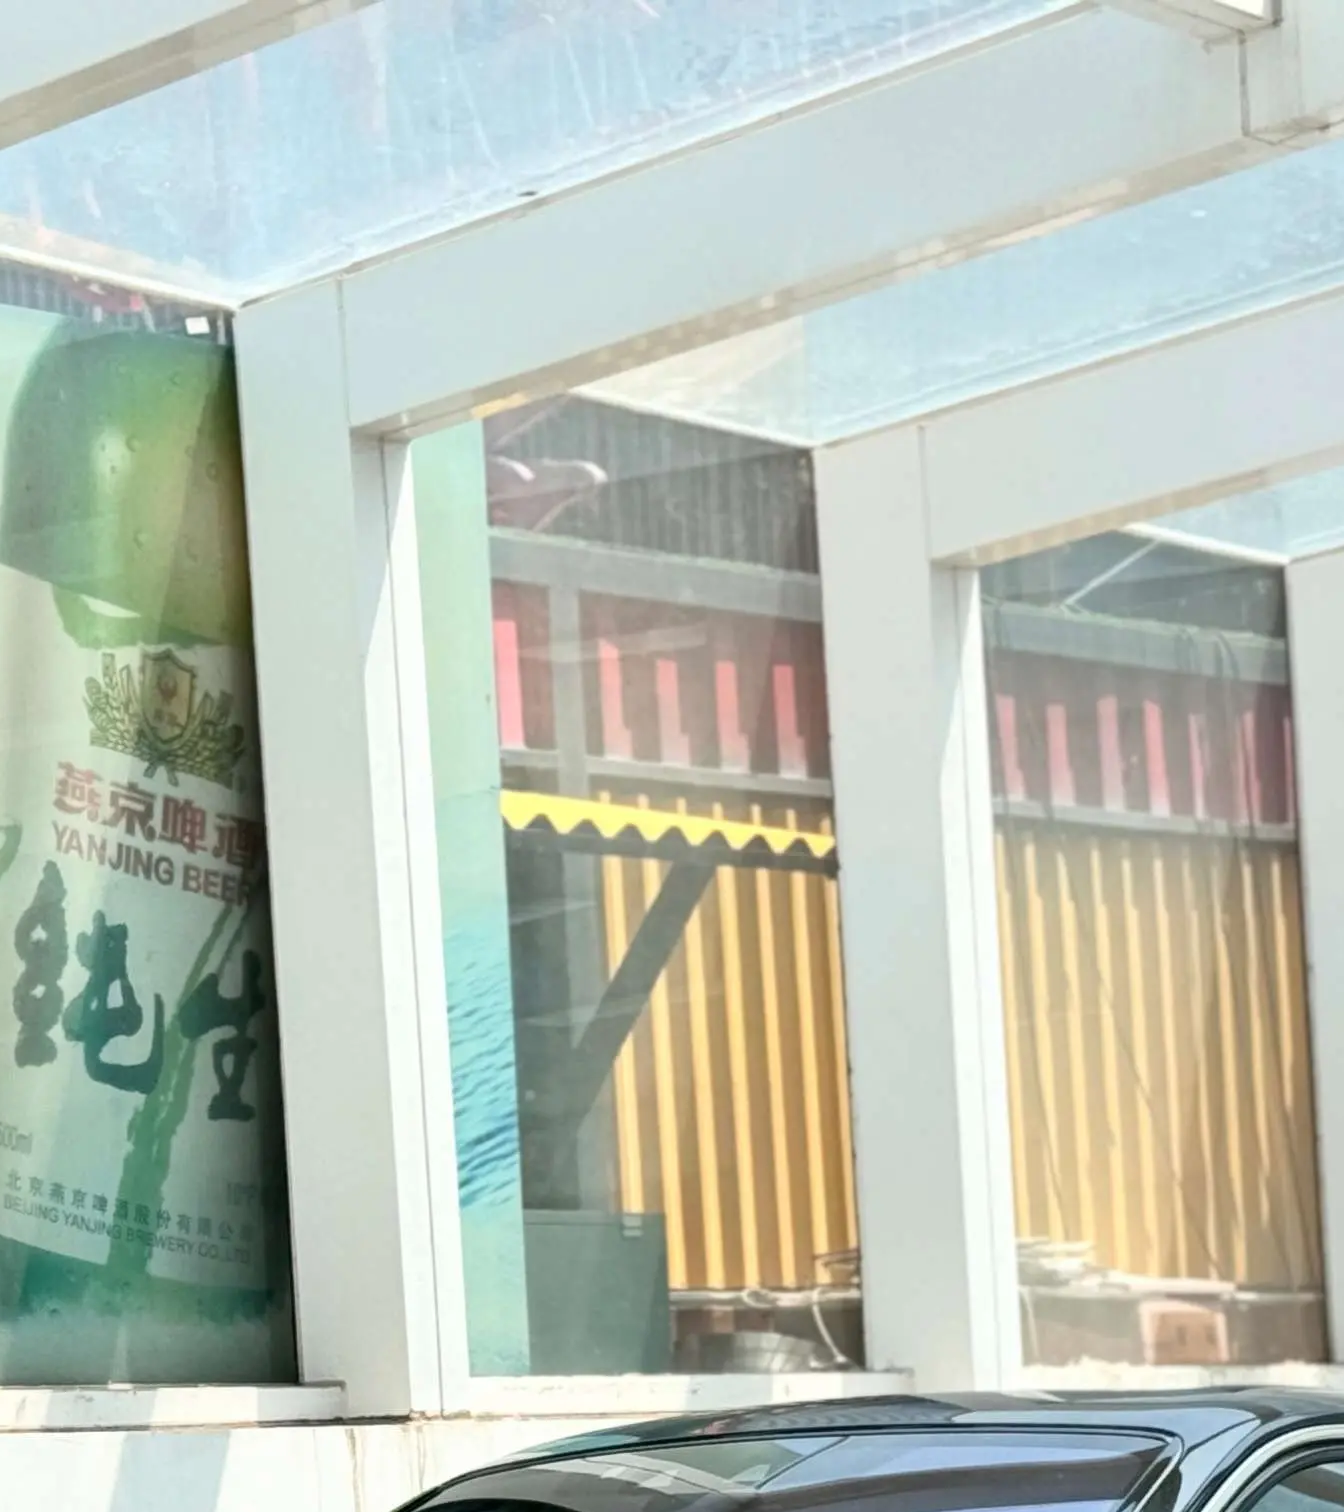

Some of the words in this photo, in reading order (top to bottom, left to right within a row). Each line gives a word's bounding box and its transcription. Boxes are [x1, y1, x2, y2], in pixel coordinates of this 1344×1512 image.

[53, 762, 264, 867] 燕京啤酒
[52, 820, 174, 886] YANJING
[4, 1194, 59, 1224] BEIJING
[63, 1210, 122, 1240] YANJING
[126, 1227, 195, 1256] BREWERY
